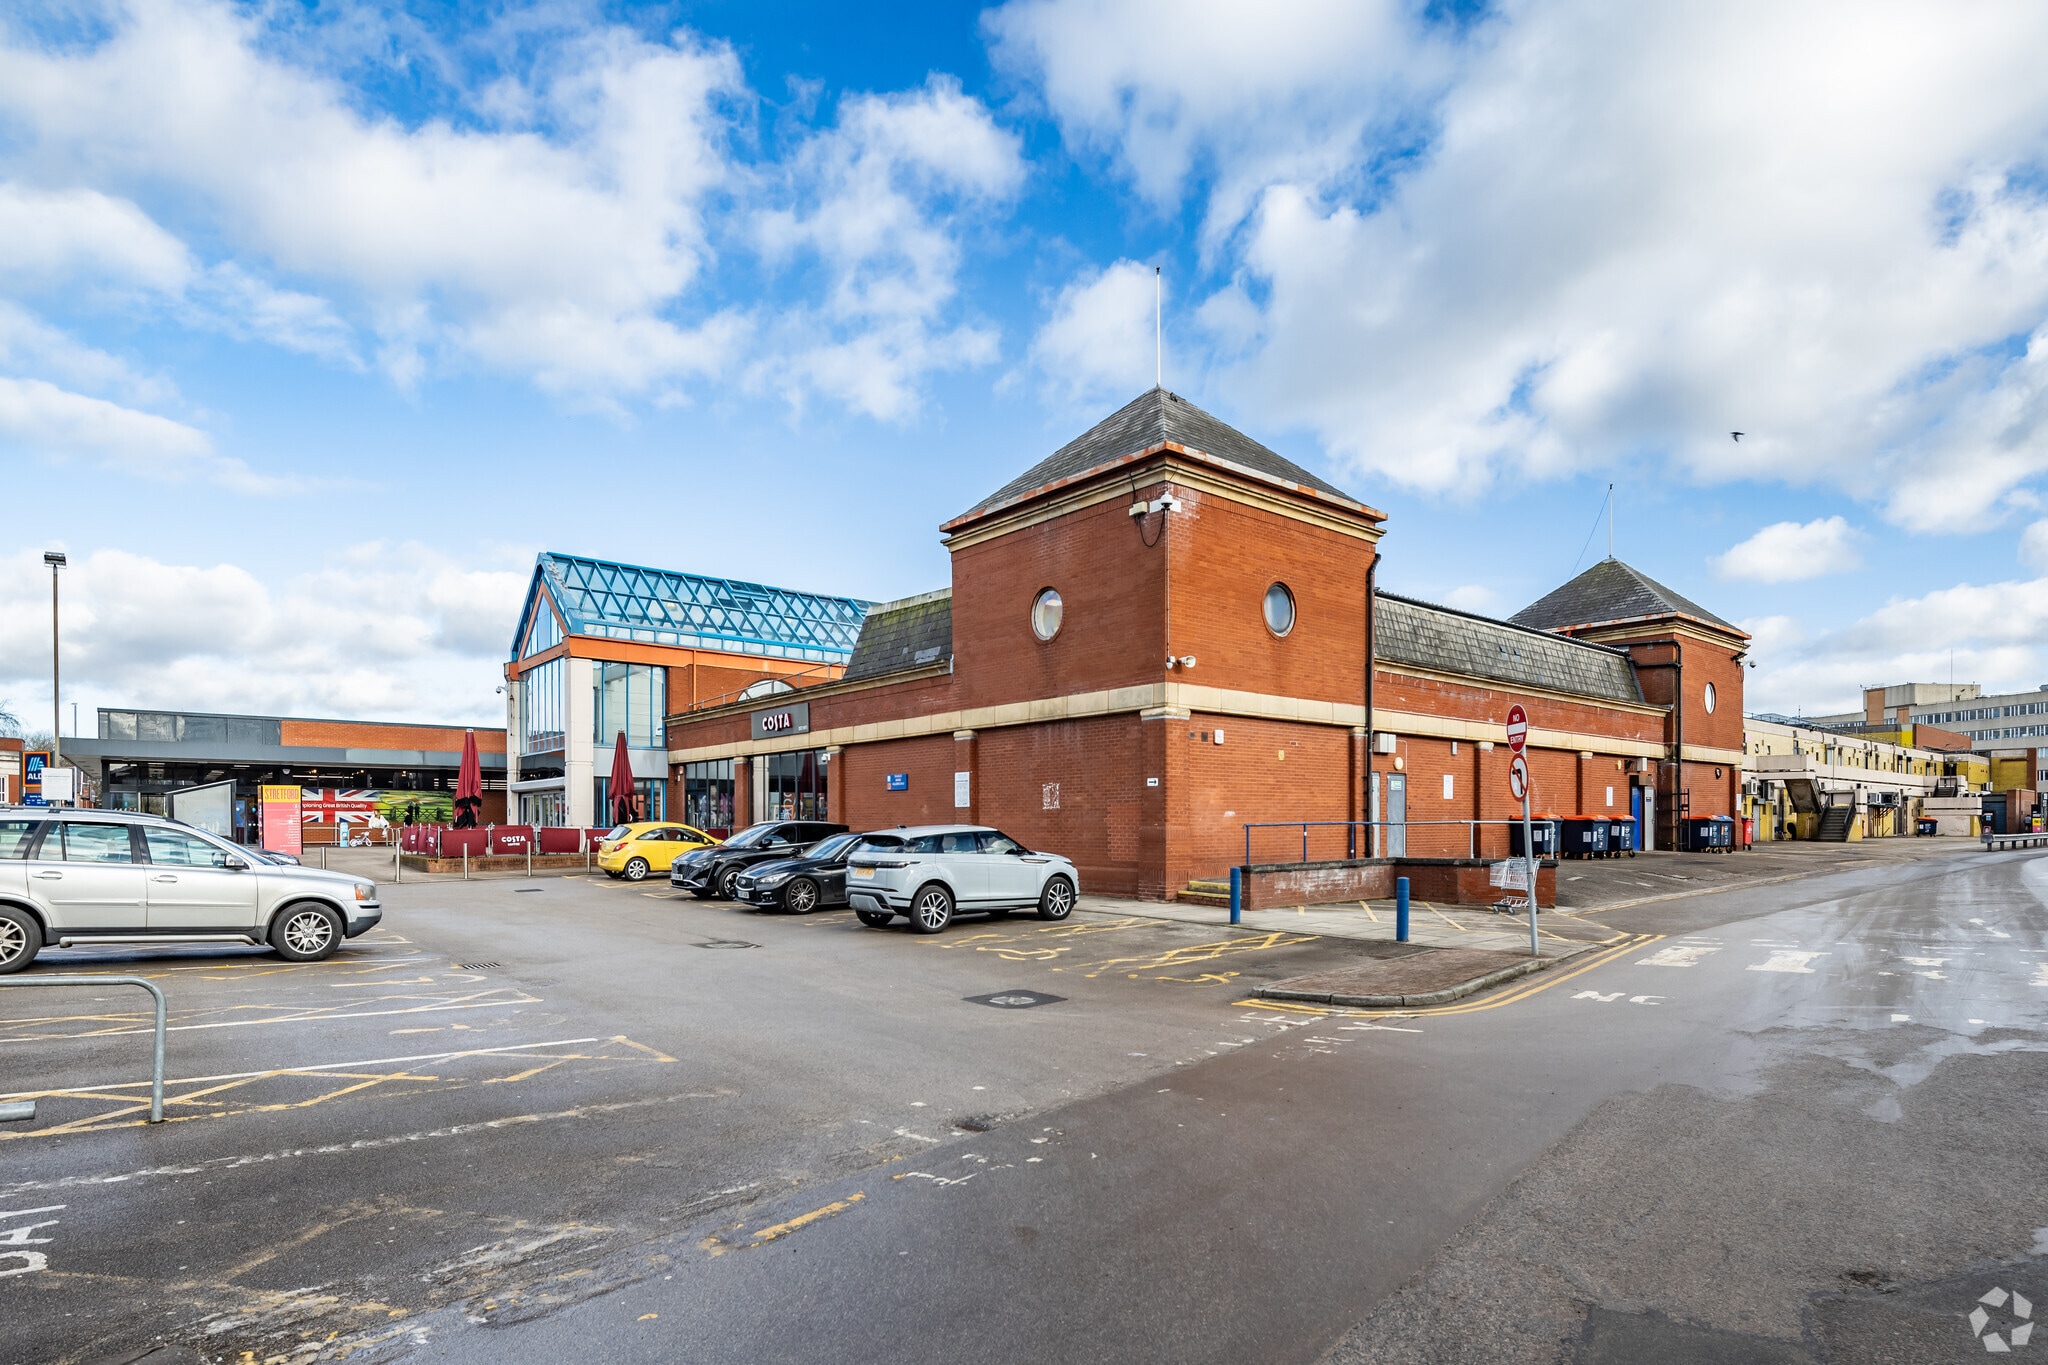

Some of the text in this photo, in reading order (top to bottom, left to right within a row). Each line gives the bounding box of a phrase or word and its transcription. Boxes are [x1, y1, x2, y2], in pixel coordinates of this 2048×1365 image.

[762, 713, 791, 731] COSTA
[1513, 713, 1520, 723] NO
[1510, 734, 1524, 745] ENTRY
[27, 772, 42, 780] ALD
[264, 788, 299, 800] STRETFORD
[501, 835, 526, 843] COSTA
